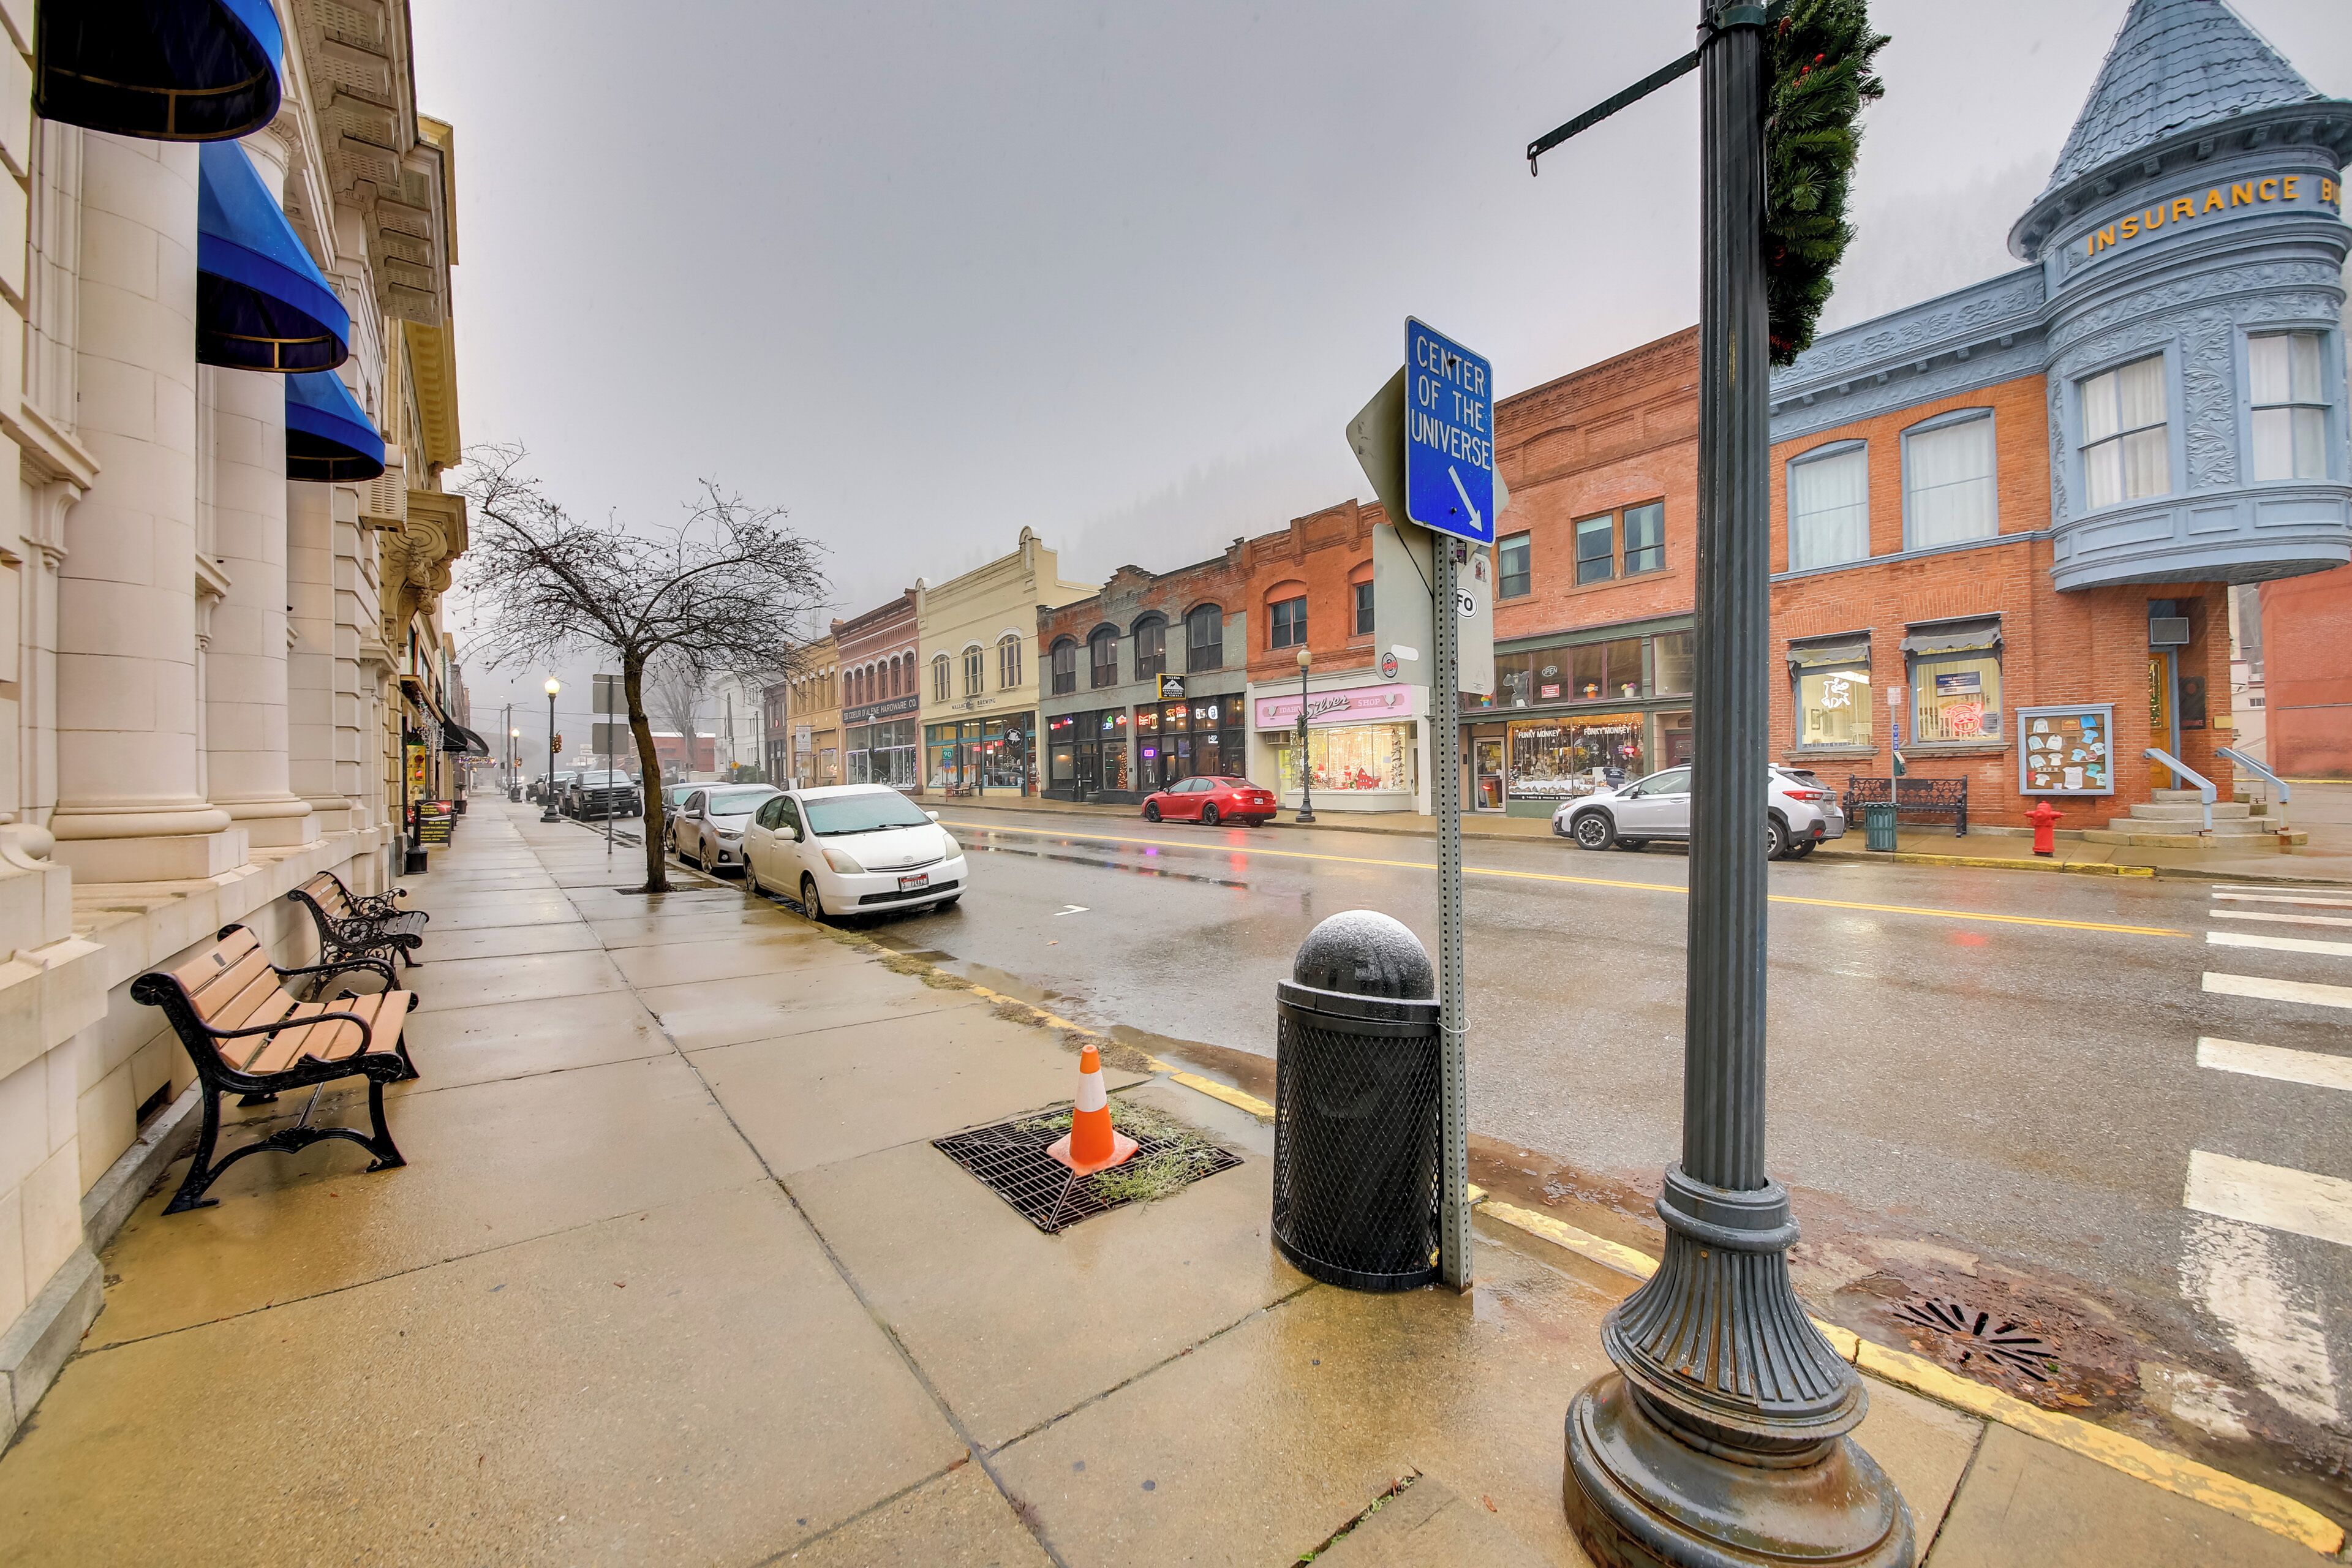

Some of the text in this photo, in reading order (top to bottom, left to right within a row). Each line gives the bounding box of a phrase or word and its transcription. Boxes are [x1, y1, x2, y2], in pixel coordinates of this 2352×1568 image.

[2087, 176, 2300, 256] INSURANCE
[1417, 336, 1485, 398] CENTER
[1419, 375, 1485, 432] OF THE
[1411, 409, 1491, 470] UNIVERSE
[848, 710, 861, 720] COEUR
[880, 700, 907, 713] HARDWARE
[908, 698, 917, 708] CO.
[1303, 695, 1349, 720] Silver
[1358, 698, 1381, 707] SHOP
[1536, 729, 1559, 738] MONKEY
[1584, 726, 1630, 736] FUNKY MONKEY
